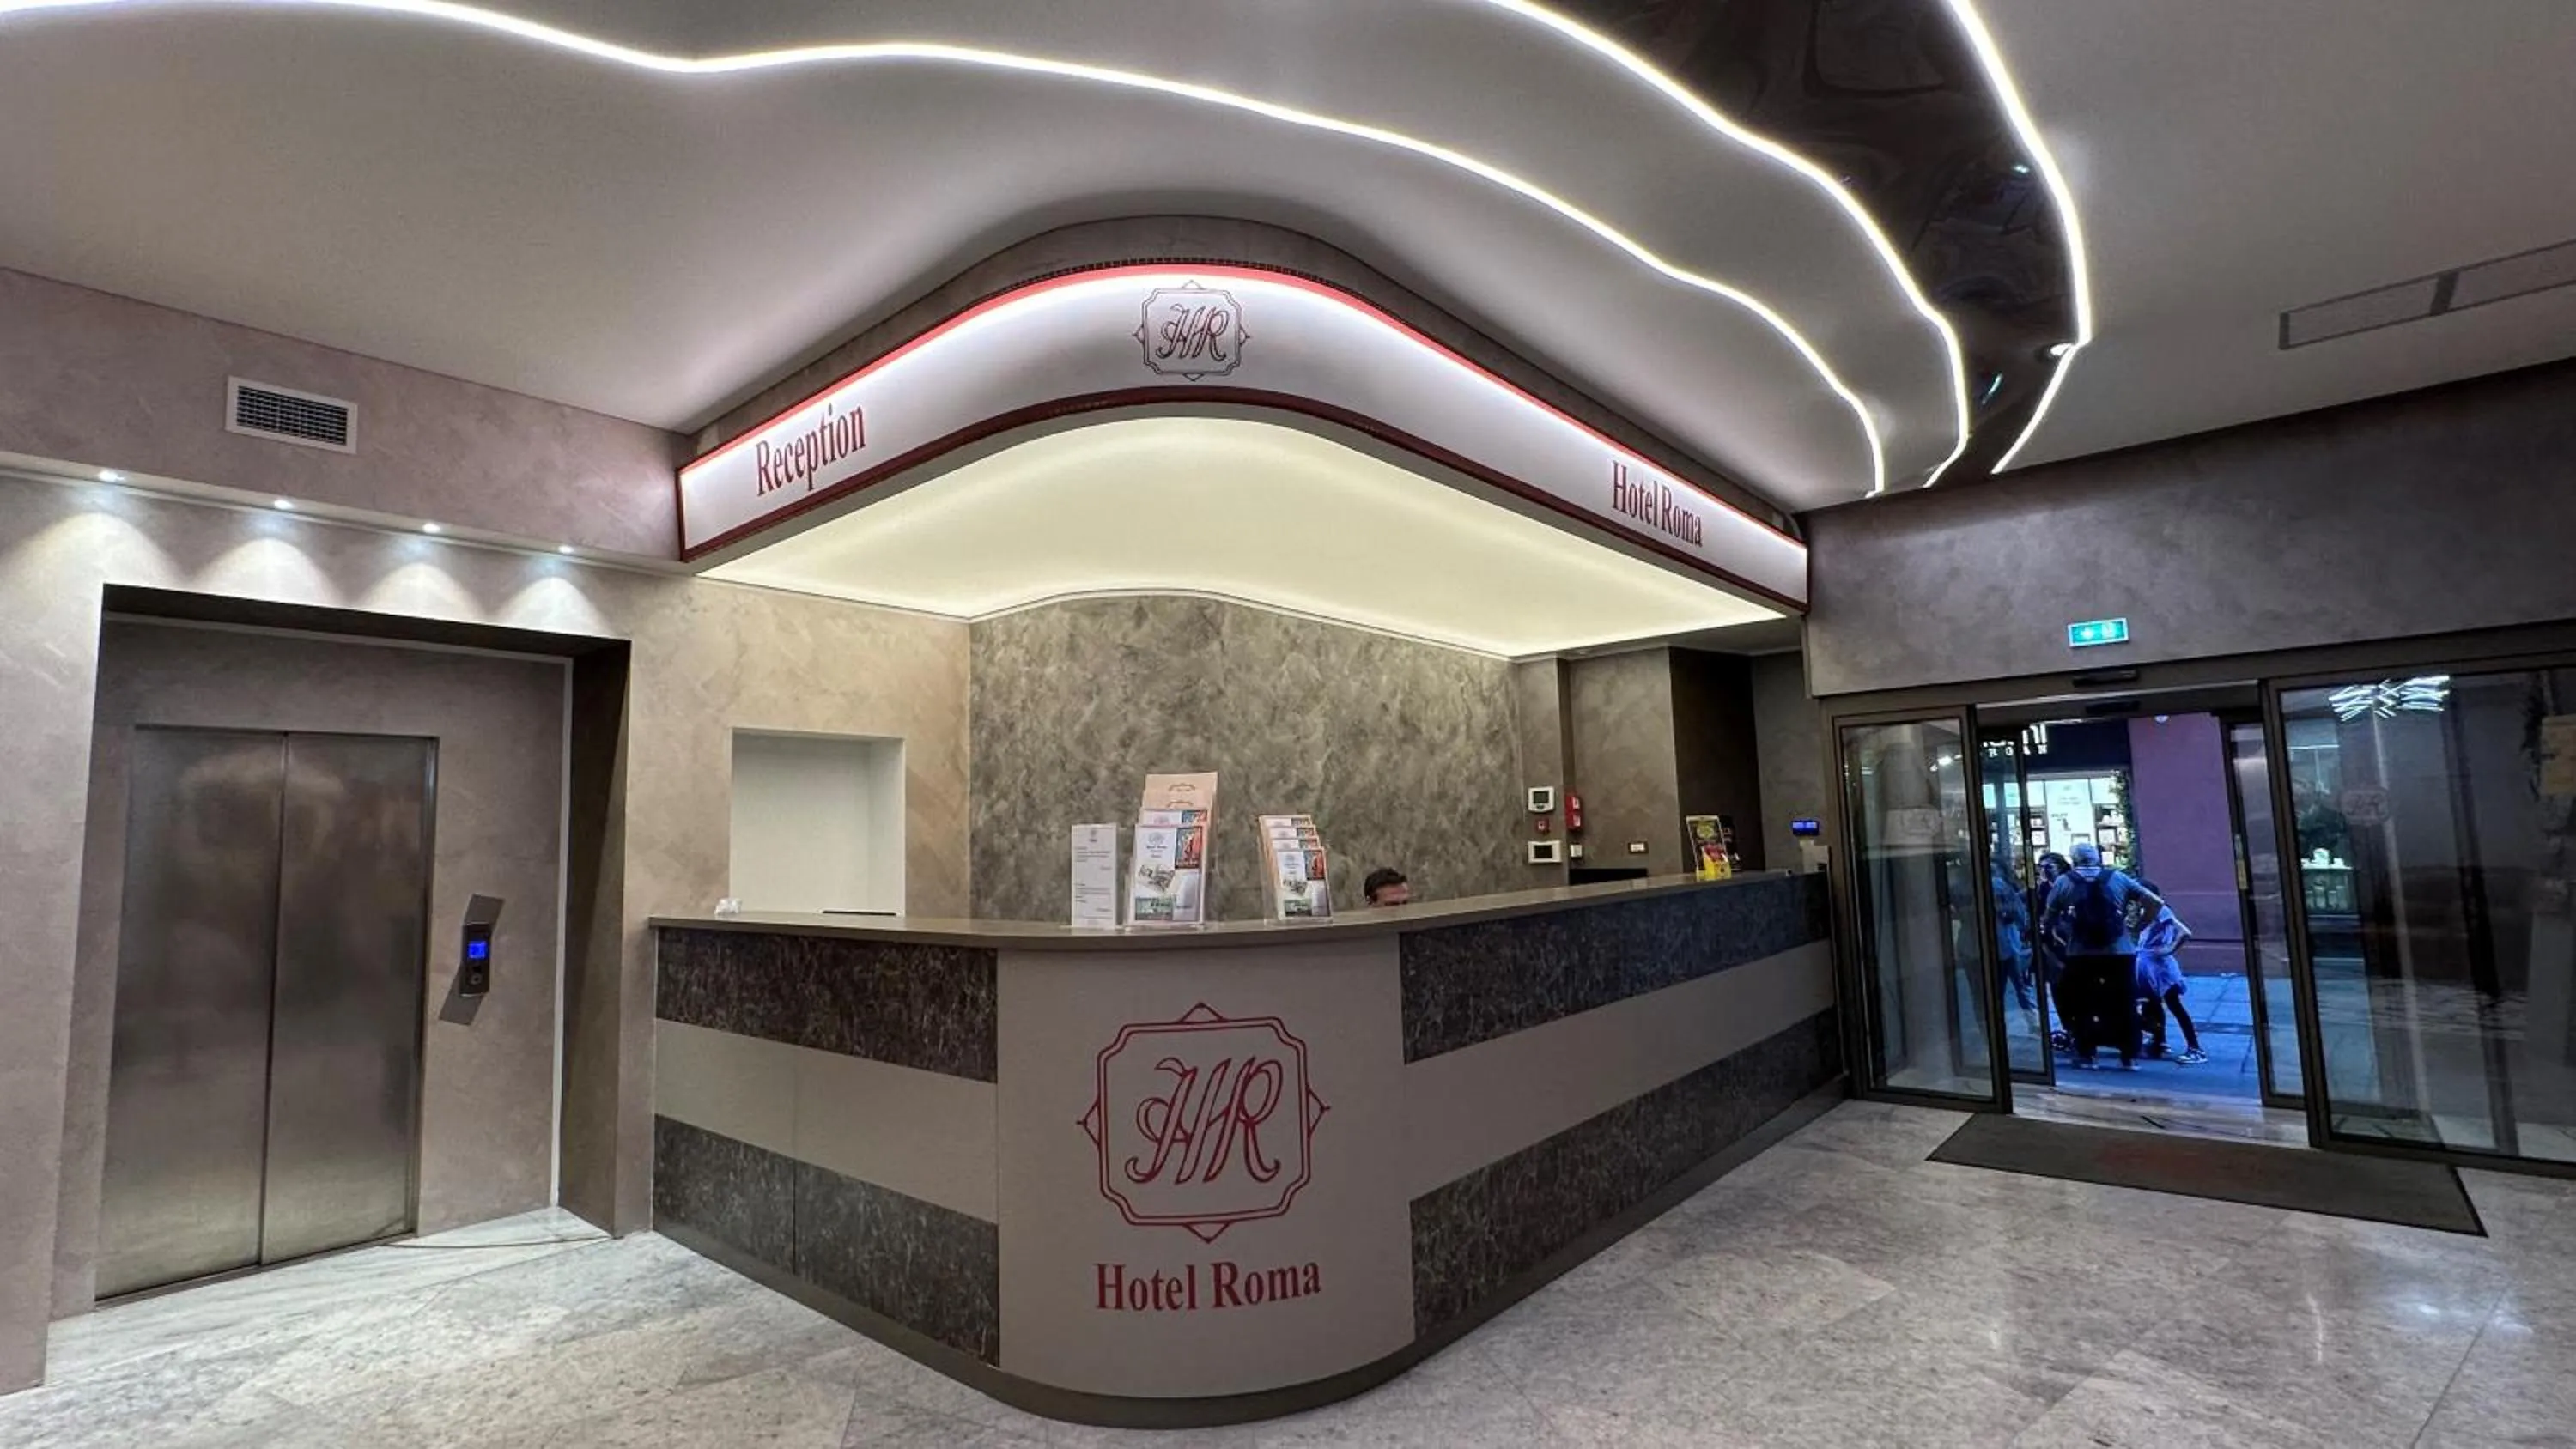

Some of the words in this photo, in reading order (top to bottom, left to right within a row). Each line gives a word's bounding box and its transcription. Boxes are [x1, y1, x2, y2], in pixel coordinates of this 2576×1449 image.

[756, 403, 866, 497] Reception
[1612, 459, 1658, 528] Hotel
[1662, 483, 1703, 548] Roma
[1094, 1263, 1200, 1311] Hotel
[1211, 1261, 1321, 1308] Roma
